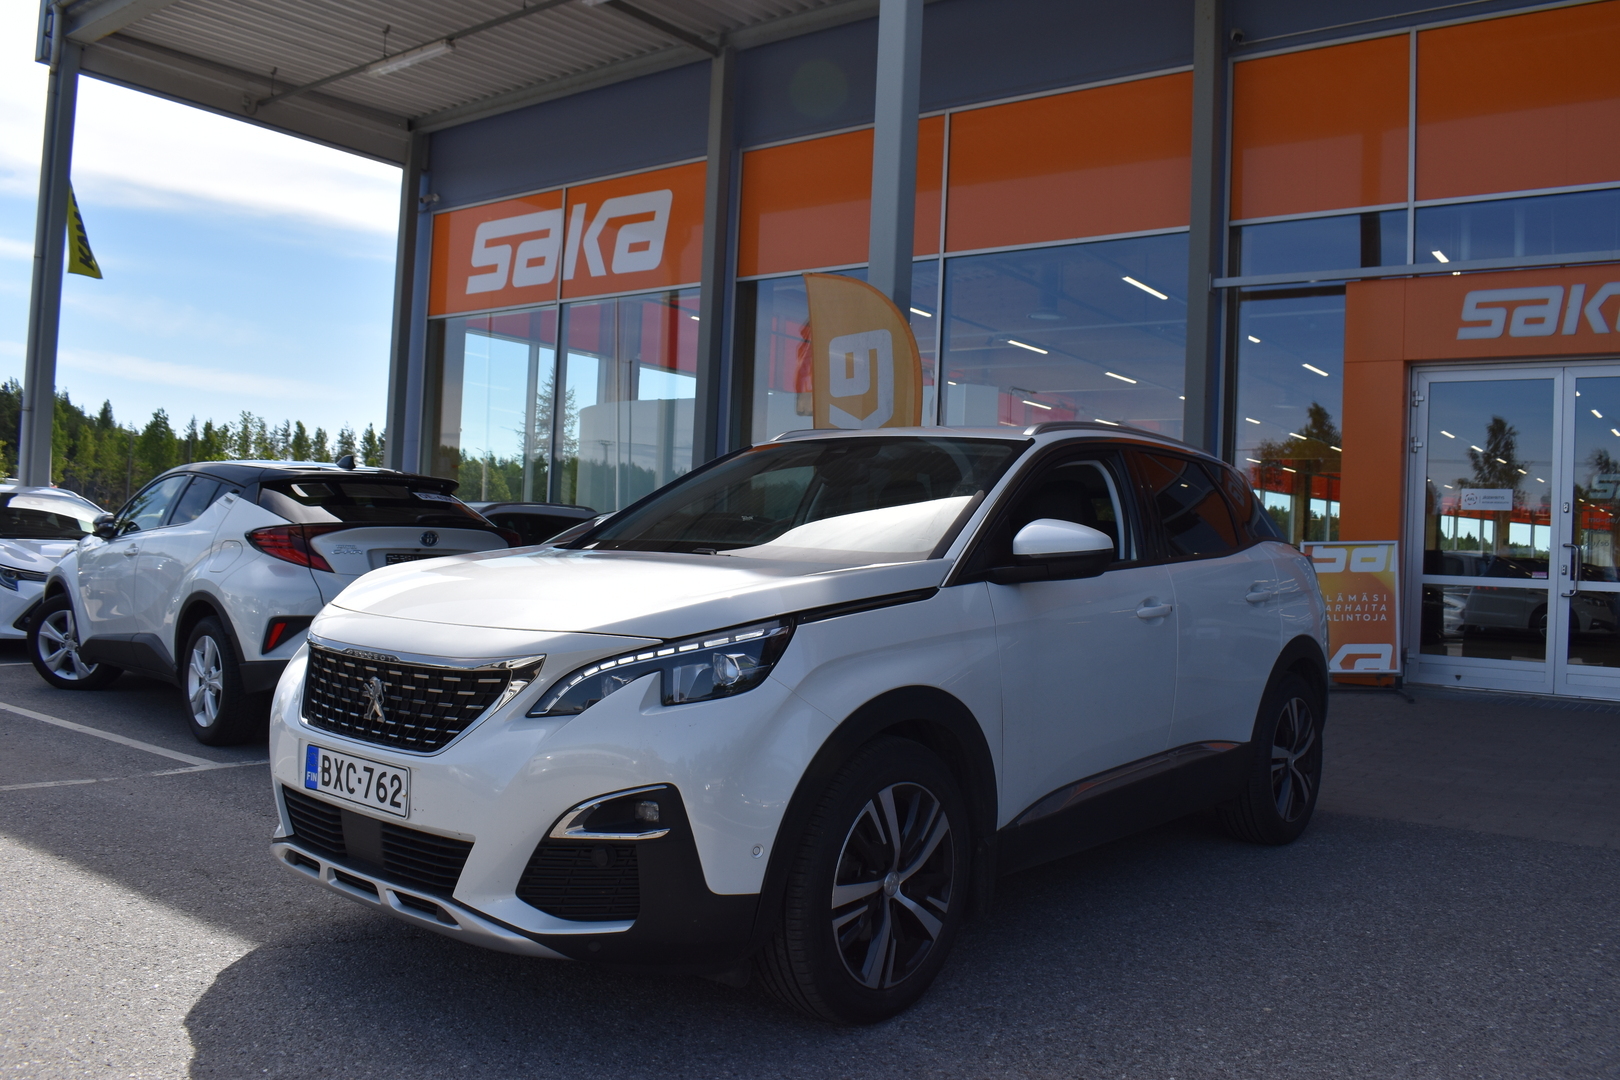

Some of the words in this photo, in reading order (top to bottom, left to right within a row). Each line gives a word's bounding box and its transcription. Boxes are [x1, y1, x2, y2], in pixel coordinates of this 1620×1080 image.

[1456, 281, 1620, 341] sak
[1326, 592, 1387, 602] LÄMÄSI
[1326, 604, 1387, 612] ARHAITA
[1326, 614, 1387, 622] ALINTOJA
[306, 770, 318, 782] FIN
[321, 754, 402, 809] BXC-762
